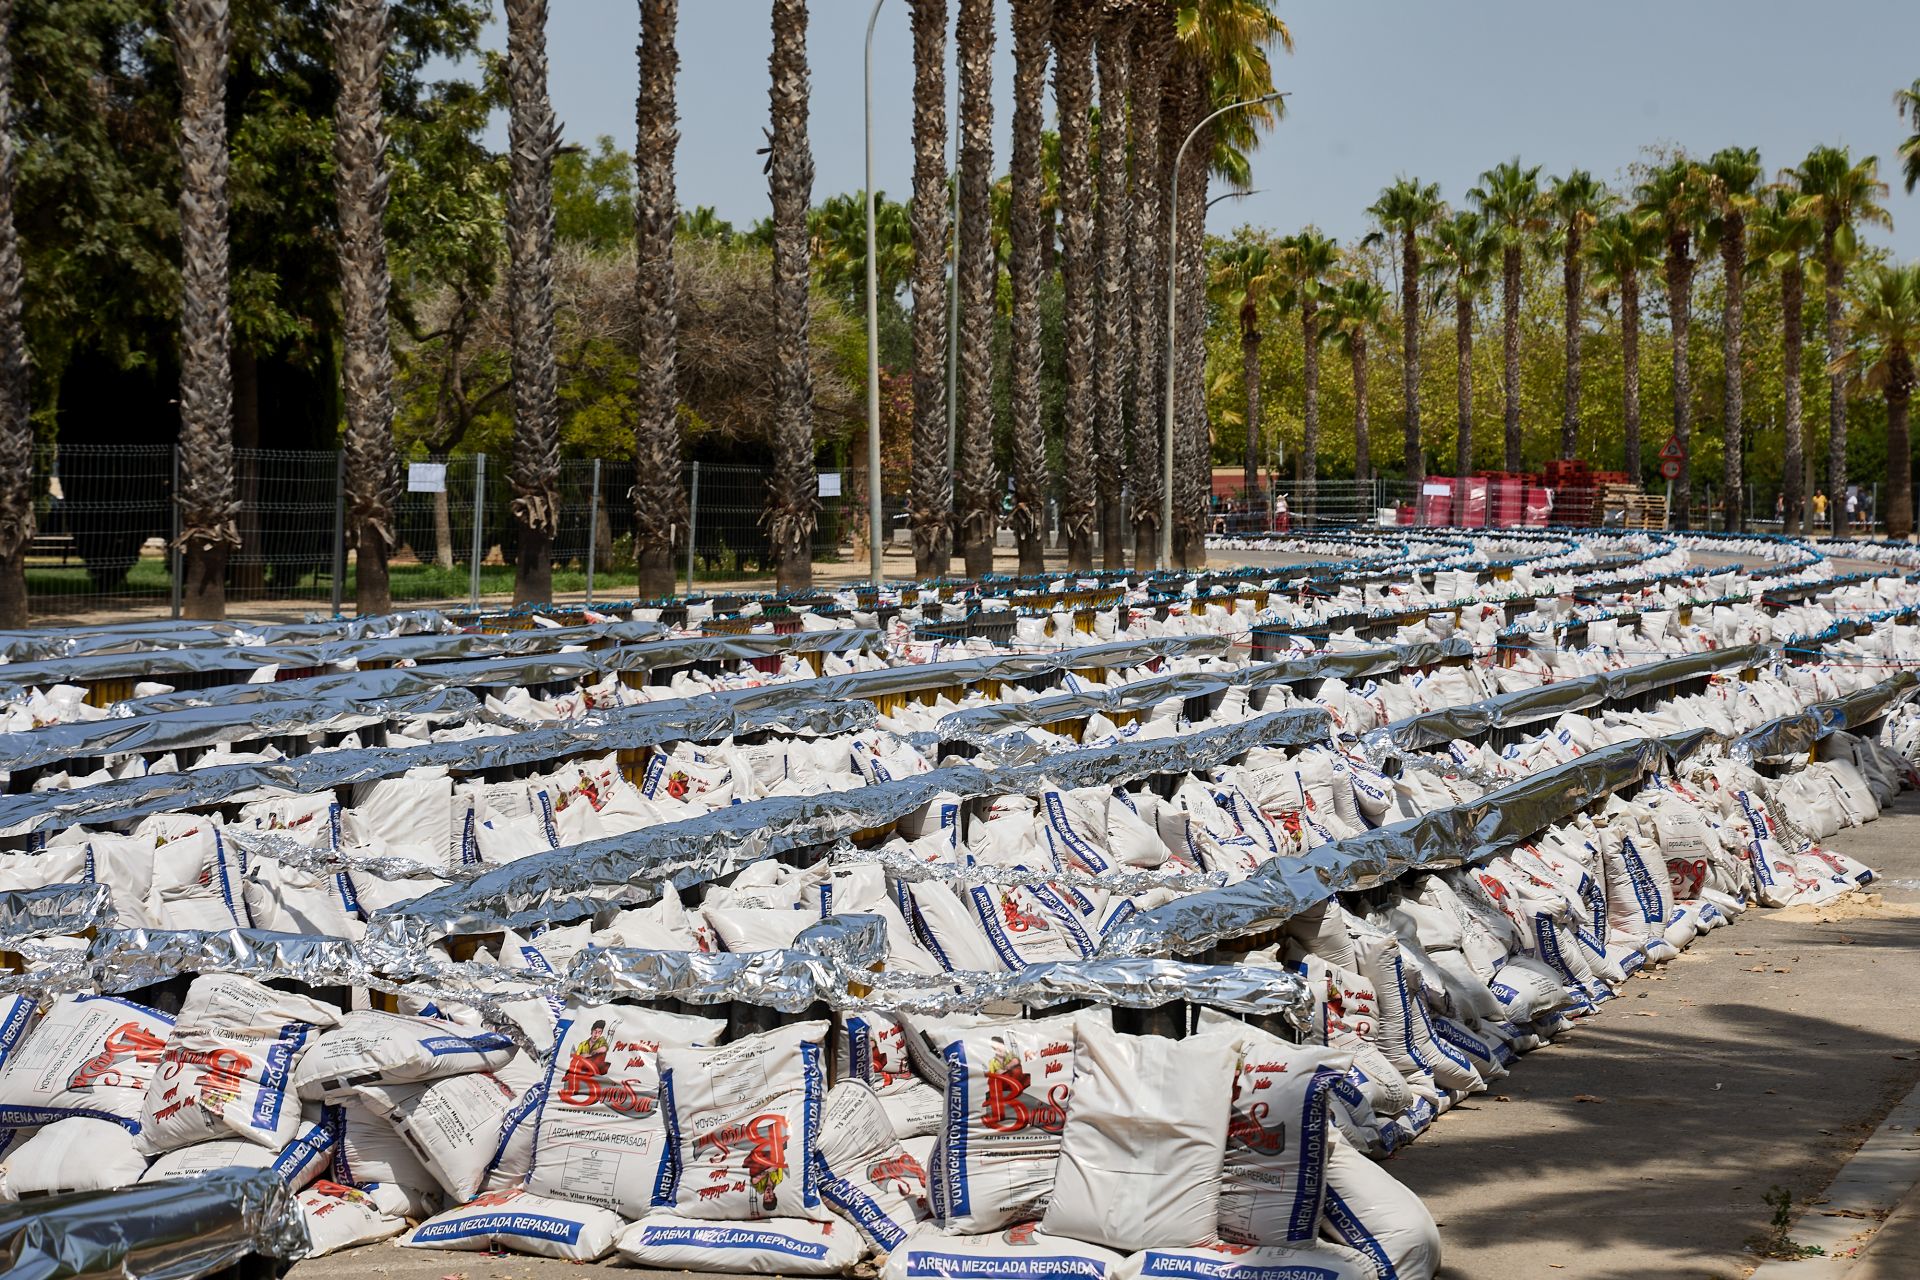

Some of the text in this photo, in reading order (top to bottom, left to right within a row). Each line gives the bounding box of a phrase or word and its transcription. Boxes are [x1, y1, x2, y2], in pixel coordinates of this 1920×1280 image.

[529, 951, 548, 972] AREN
[3, 999, 33, 1042] REPASADA
[613, 1041, 627, 1053] Por
[624, 1057, 645, 1071] pida
[1045, 1060, 1063, 1078] pida
[1252, 1077, 1272, 1094] pida
[2, 1111, 34, 1125] ARENA
[552, 1127, 647, 1147] ARENA MEZCLADA REPASADA
[1305, 1136, 1321, 1197] MEZCLADA
[659, 1162, 673, 1199] ARENA
[422, 1216, 570, 1237] ARENA MEZCLADA REPASADA
[1298, 1200, 1314, 1232] ARENA
[653, 1227, 818, 1255] ARENA MEZCLADA REPASADA
[918, 1256, 1095, 1277] ARENA MEZCLADA REPASADA
[1151, 1257, 1325, 1280] ARENA MEZCLADA REPASADA
